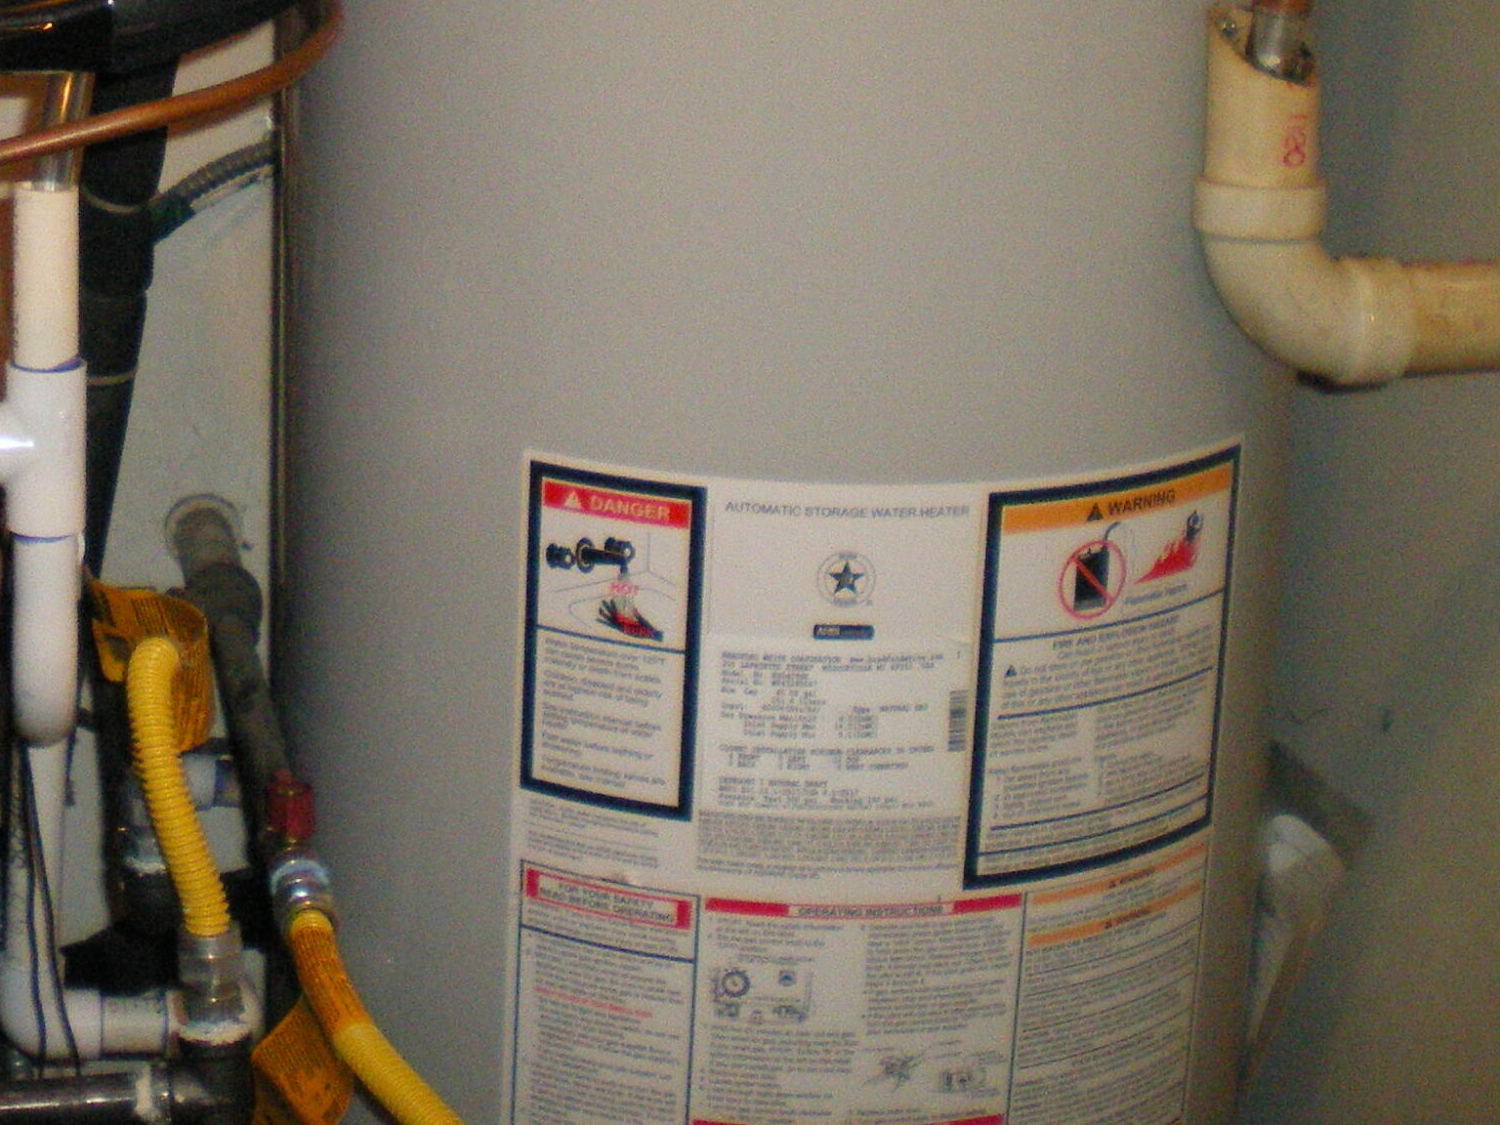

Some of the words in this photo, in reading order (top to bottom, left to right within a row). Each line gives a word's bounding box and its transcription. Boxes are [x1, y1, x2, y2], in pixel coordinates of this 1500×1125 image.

[590, 494, 671, 521] DANGER
[725, 501, 802, 517] AUTOMATIC
[804, 506, 867, 519] STORAGE
[871, 507, 915, 519] WATER
[920, 504, 971, 517] HEATER
[1107, 489, 1176, 516] WARNING
